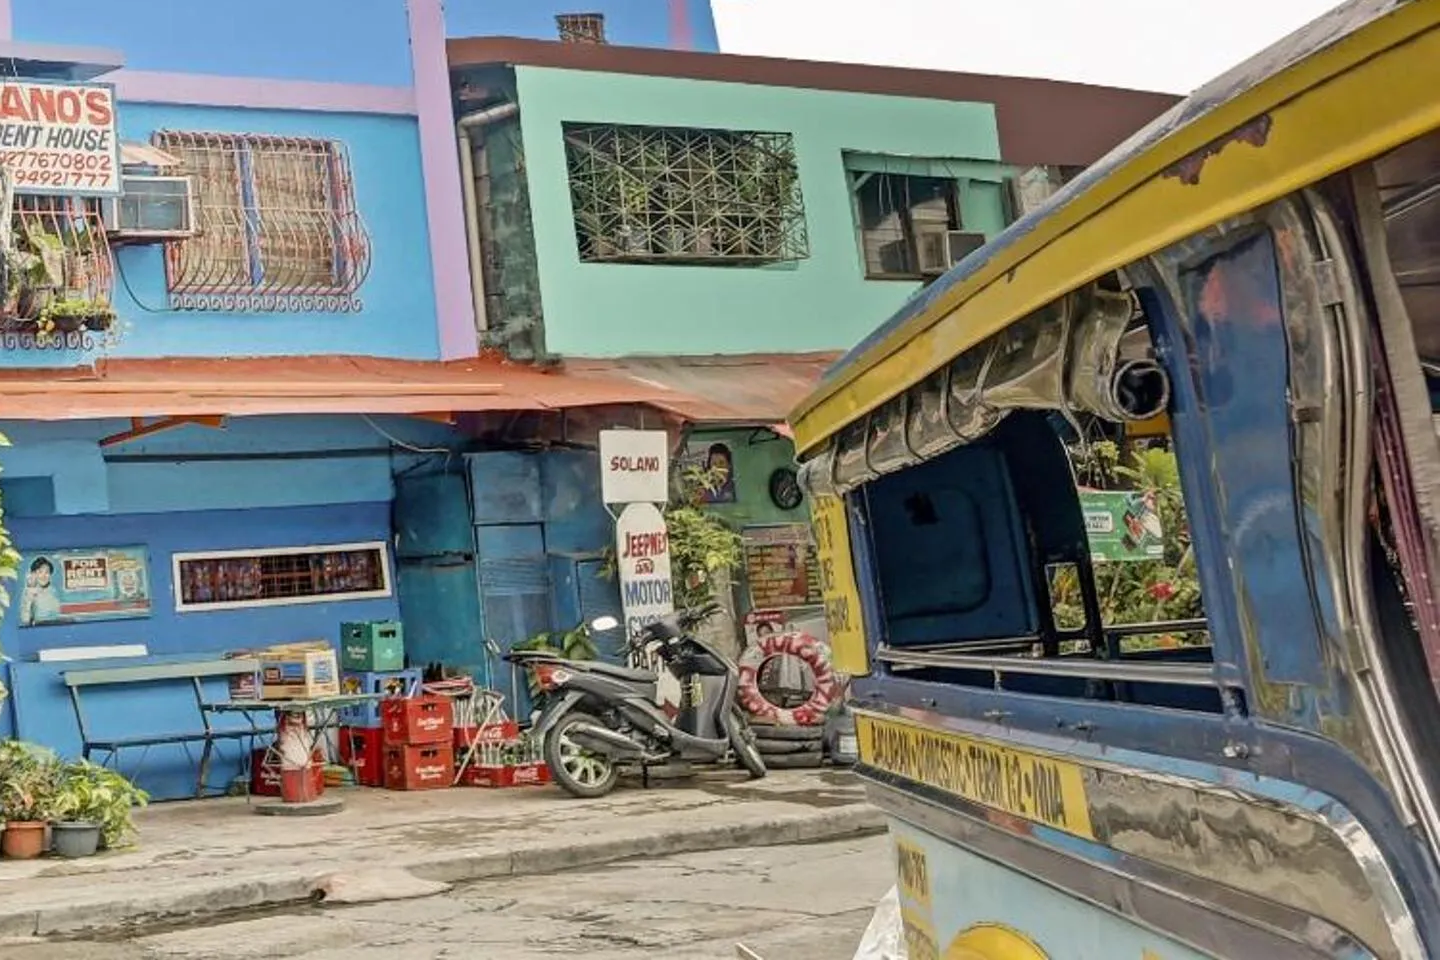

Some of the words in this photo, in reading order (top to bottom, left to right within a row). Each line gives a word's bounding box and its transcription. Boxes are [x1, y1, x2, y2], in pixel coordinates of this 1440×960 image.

[45, 126, 111, 151] HOUSE
[610, 456, 660, 472] SOLANO
[624, 580, 671, 607] MOTOR
